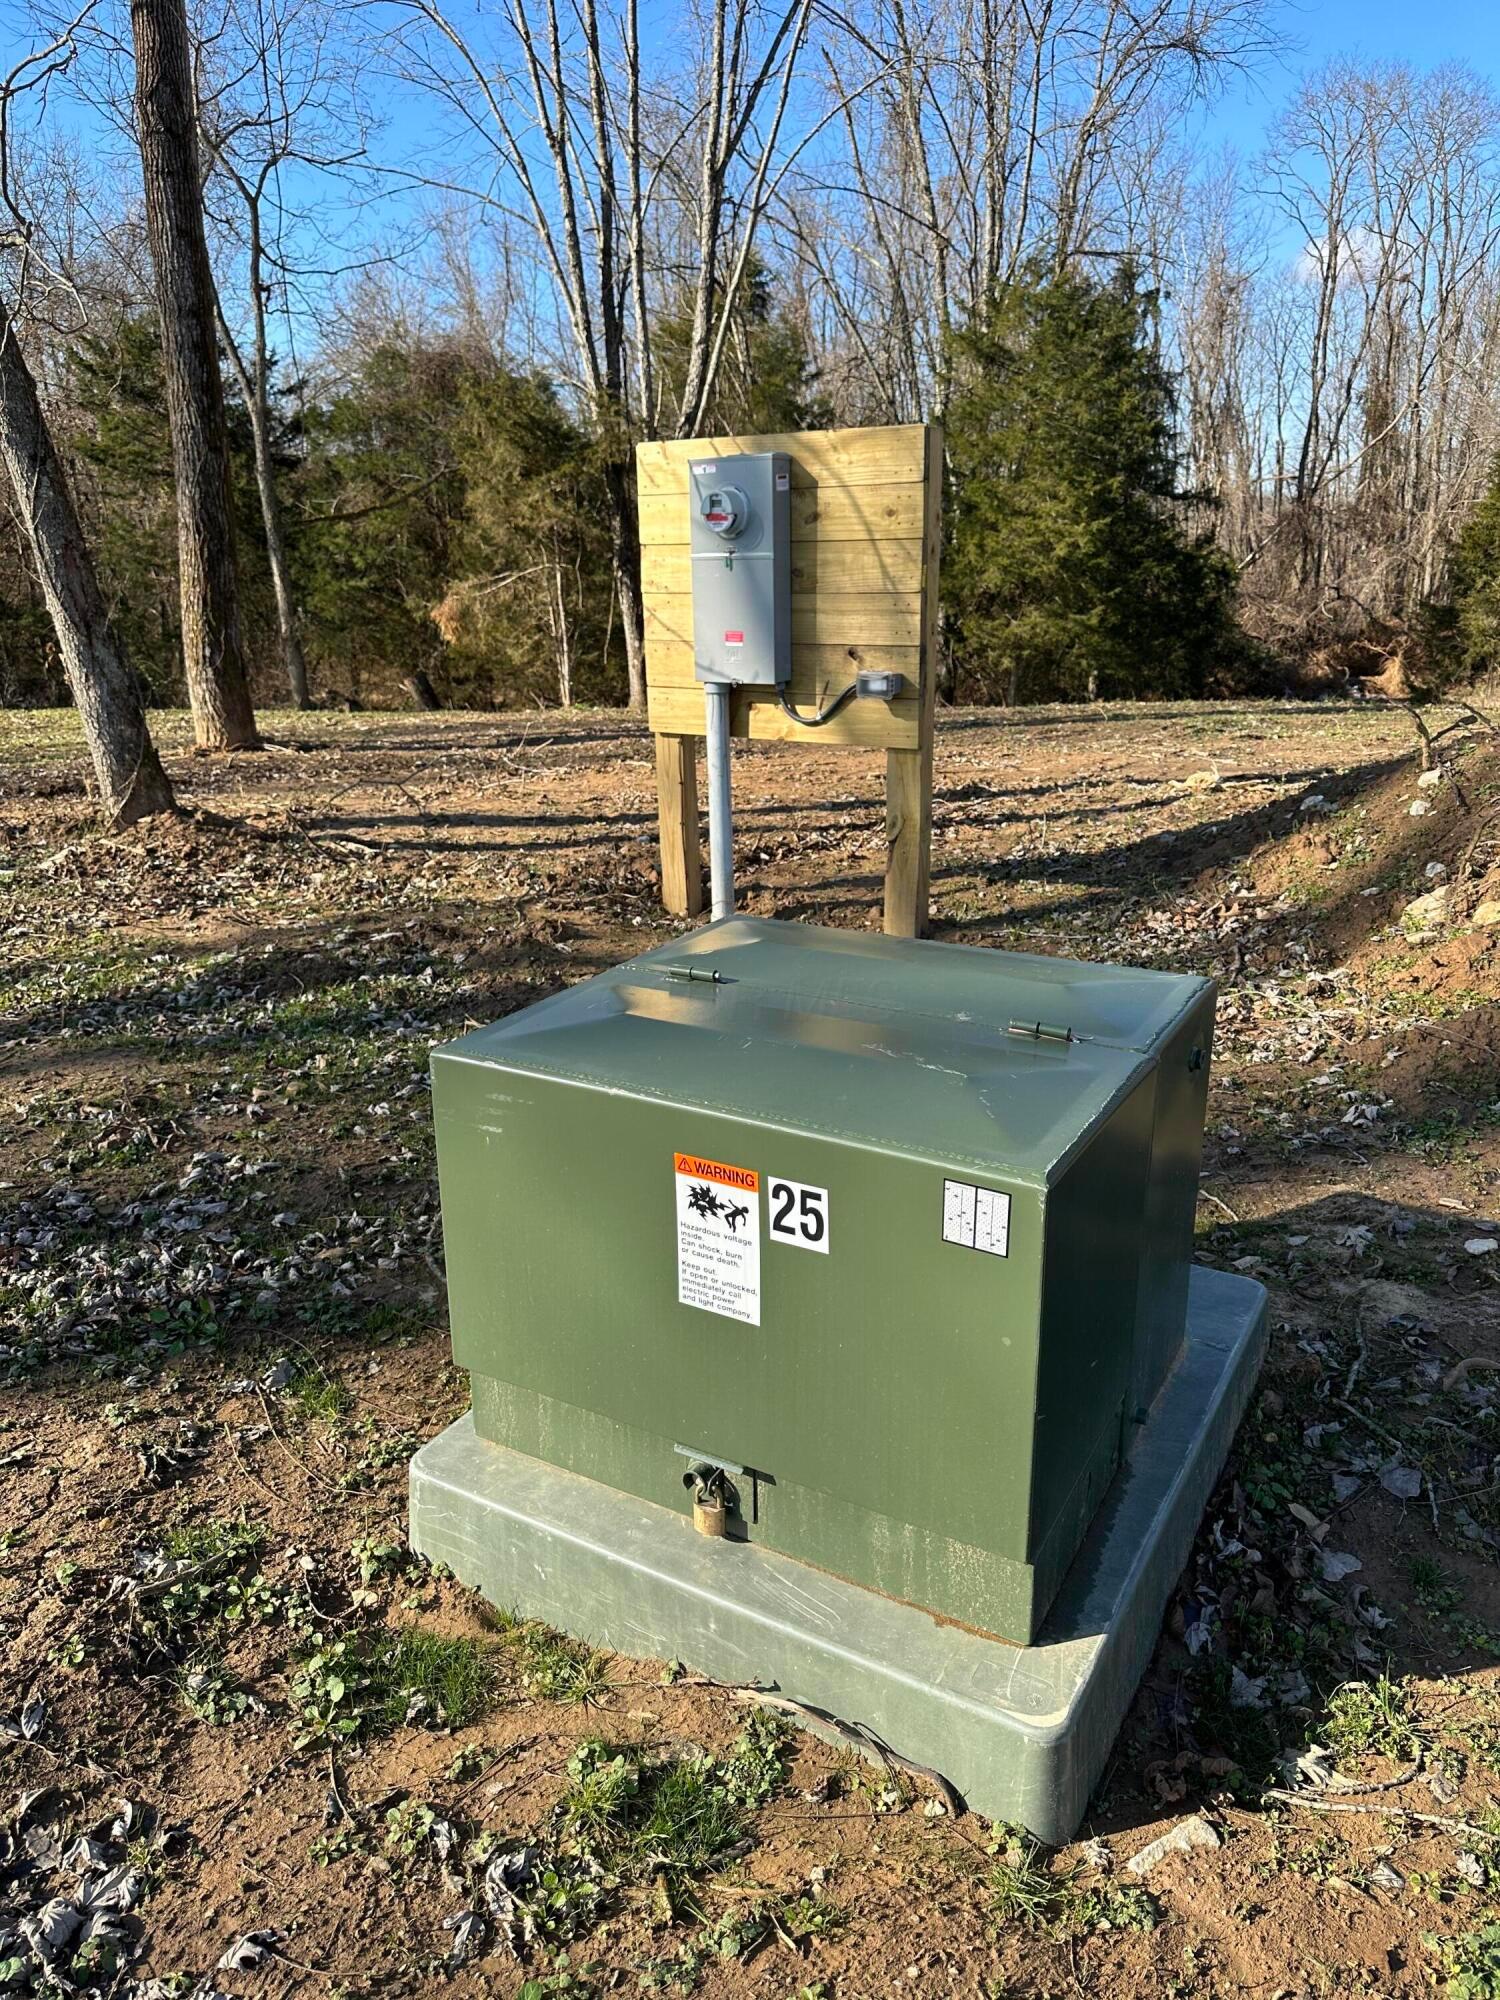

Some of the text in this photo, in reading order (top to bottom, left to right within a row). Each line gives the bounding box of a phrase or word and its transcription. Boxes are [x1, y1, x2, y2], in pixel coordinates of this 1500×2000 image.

[694, 1161, 755, 1187] WARNING
[772, 1183, 824, 1242] 25
[681, 1221, 752, 1246] Hazardous voltage
[681, 1231, 704, 1241] inside.
[681, 1238, 742, 1260] Can shock, burn
[692, 1250, 714, 1260] cause
[717, 1257, 739, 1268] death.
[682, 1260, 700, 1271] Keep
[682, 1278, 725, 1295] immediately
[690, 1272, 708, 1281] open
[722, 1281, 757, 1296] unlocked,
[682, 1286, 735, 1305] electric power
[683, 1293, 752, 1319] and light company.
